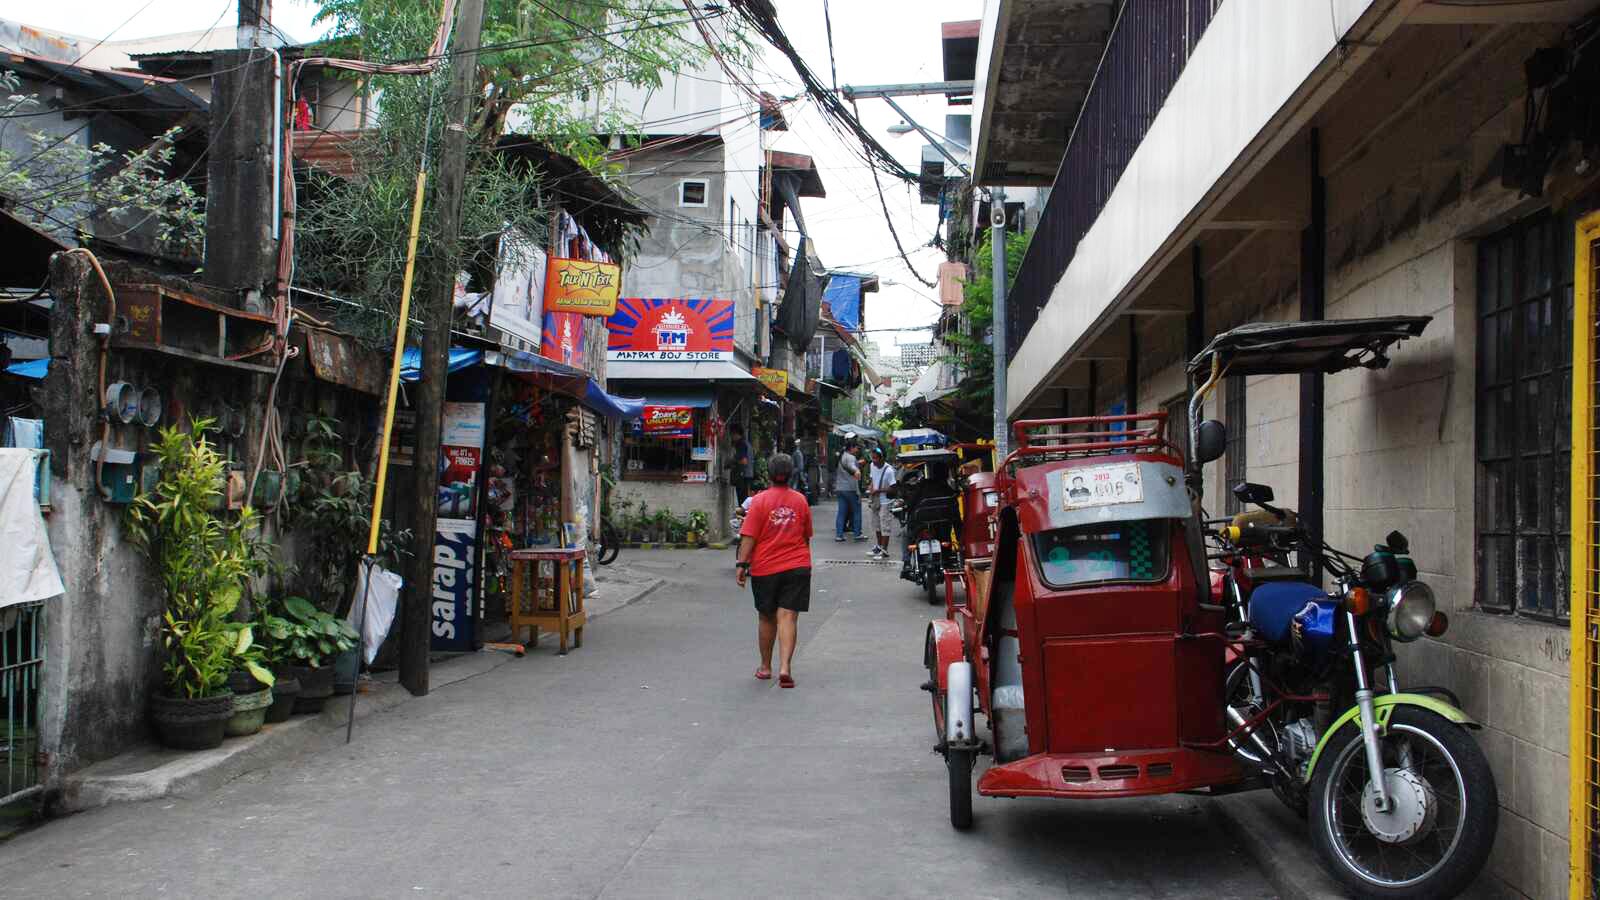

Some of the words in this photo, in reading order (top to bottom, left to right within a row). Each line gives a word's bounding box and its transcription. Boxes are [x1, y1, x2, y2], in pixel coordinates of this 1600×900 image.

[660, 332, 686, 344] TM
[686, 351, 720, 360] STORE
[432, 544, 466, 640] sarap
